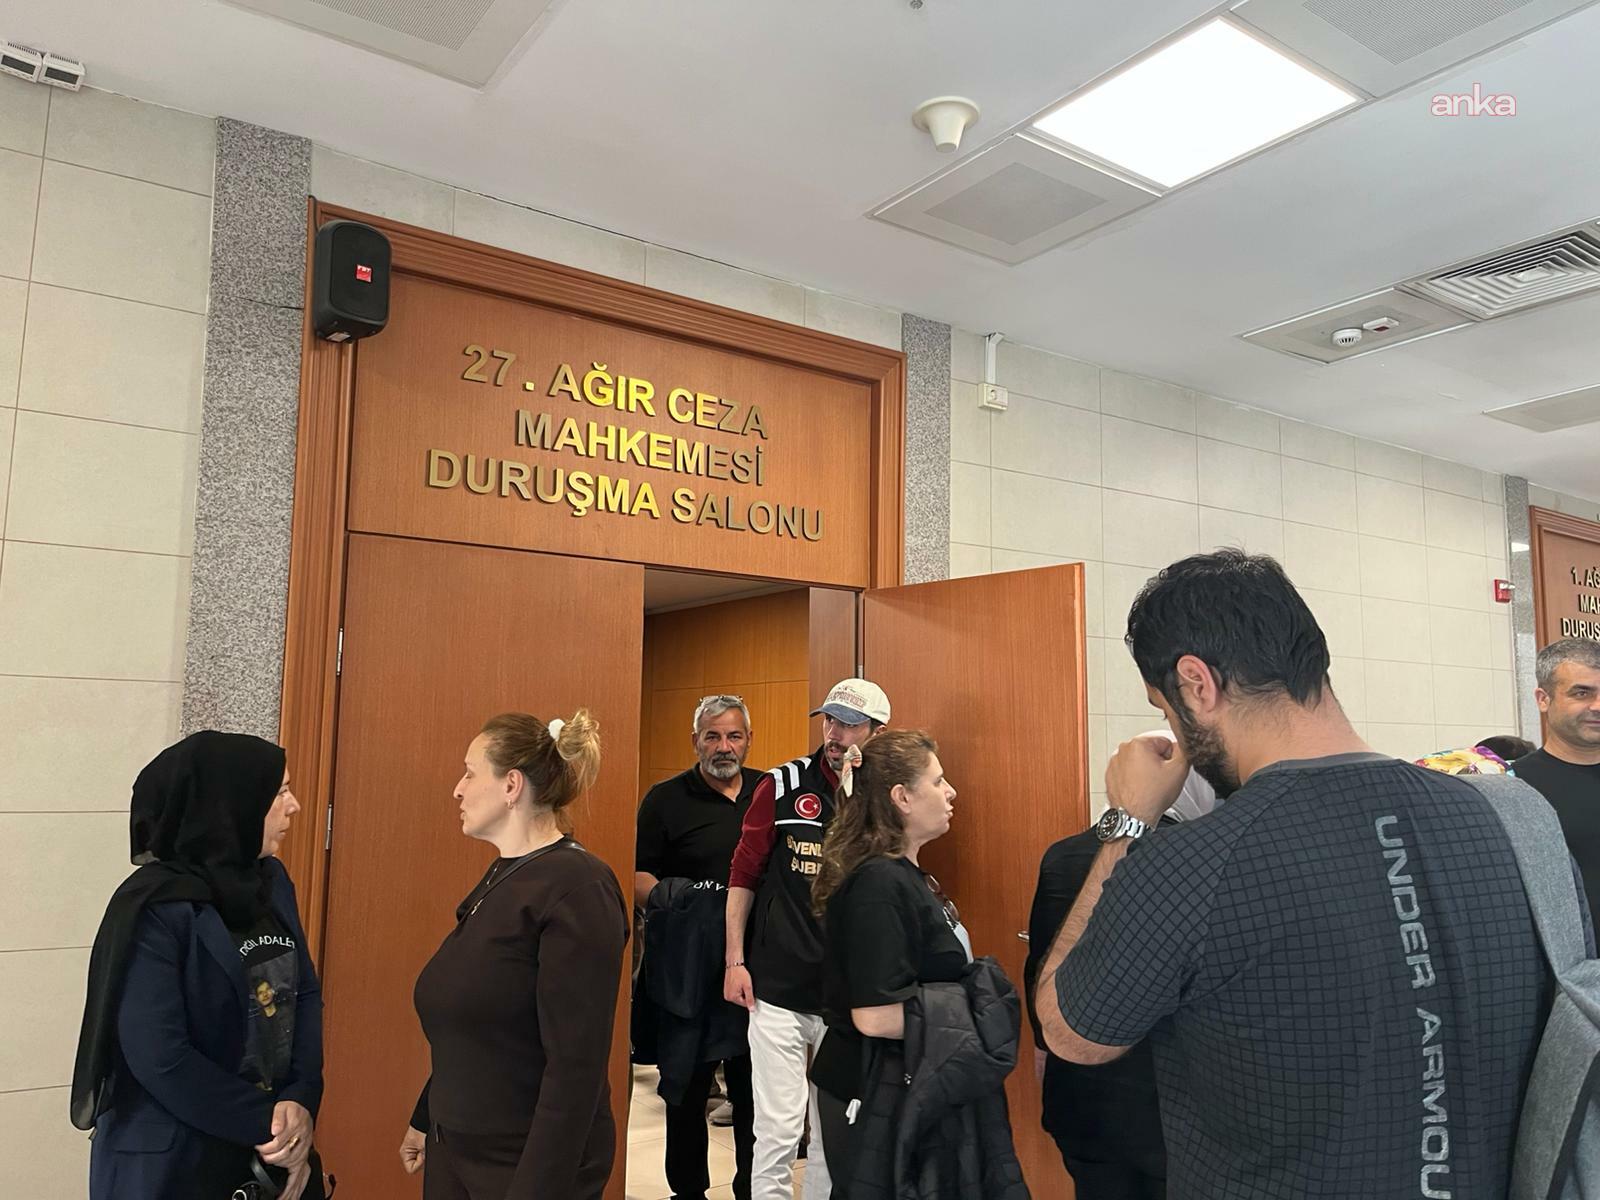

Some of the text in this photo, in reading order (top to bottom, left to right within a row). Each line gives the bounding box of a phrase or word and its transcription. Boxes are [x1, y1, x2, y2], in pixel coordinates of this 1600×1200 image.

[549, 362, 656, 417] AĞIR
[668, 387, 768, 439] CEZA
[515, 408, 764, 485] MAHKEMESİ
[428, 448, 825, 541] DURUŞMA SALONU
[1375, 815, 1452, 1200] UNDER ARMOU
